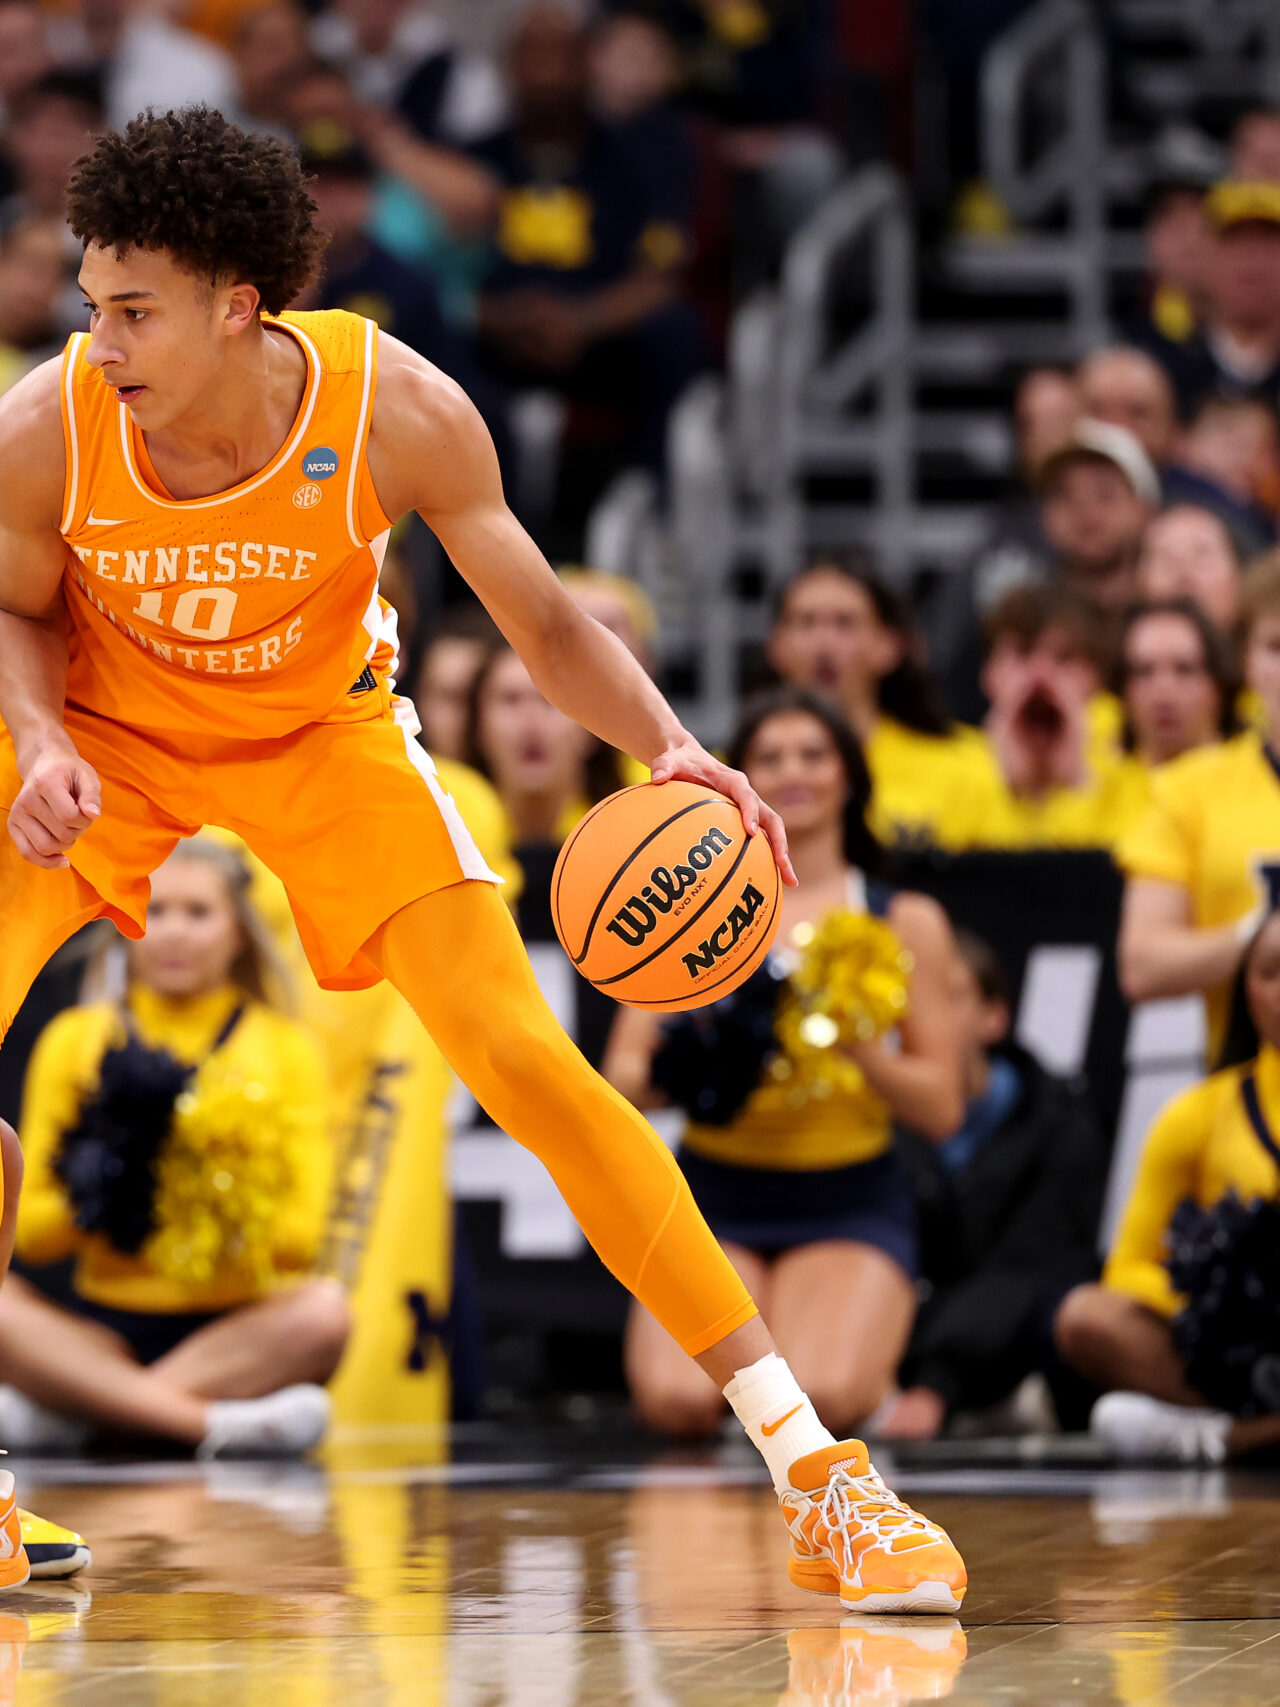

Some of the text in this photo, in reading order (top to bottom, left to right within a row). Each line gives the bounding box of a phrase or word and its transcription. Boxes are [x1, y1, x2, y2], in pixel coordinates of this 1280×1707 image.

[306, 463, 336, 473] NCAA
[295, 485, 320, 507] SEC
[73, 541, 318, 585] TENNESSEE
[132, 587, 239, 642] 10
[605, 826, 733, 947] Wilson
[673, 877, 708, 917] EVO NXT
[681, 882, 766, 979] NCAA
